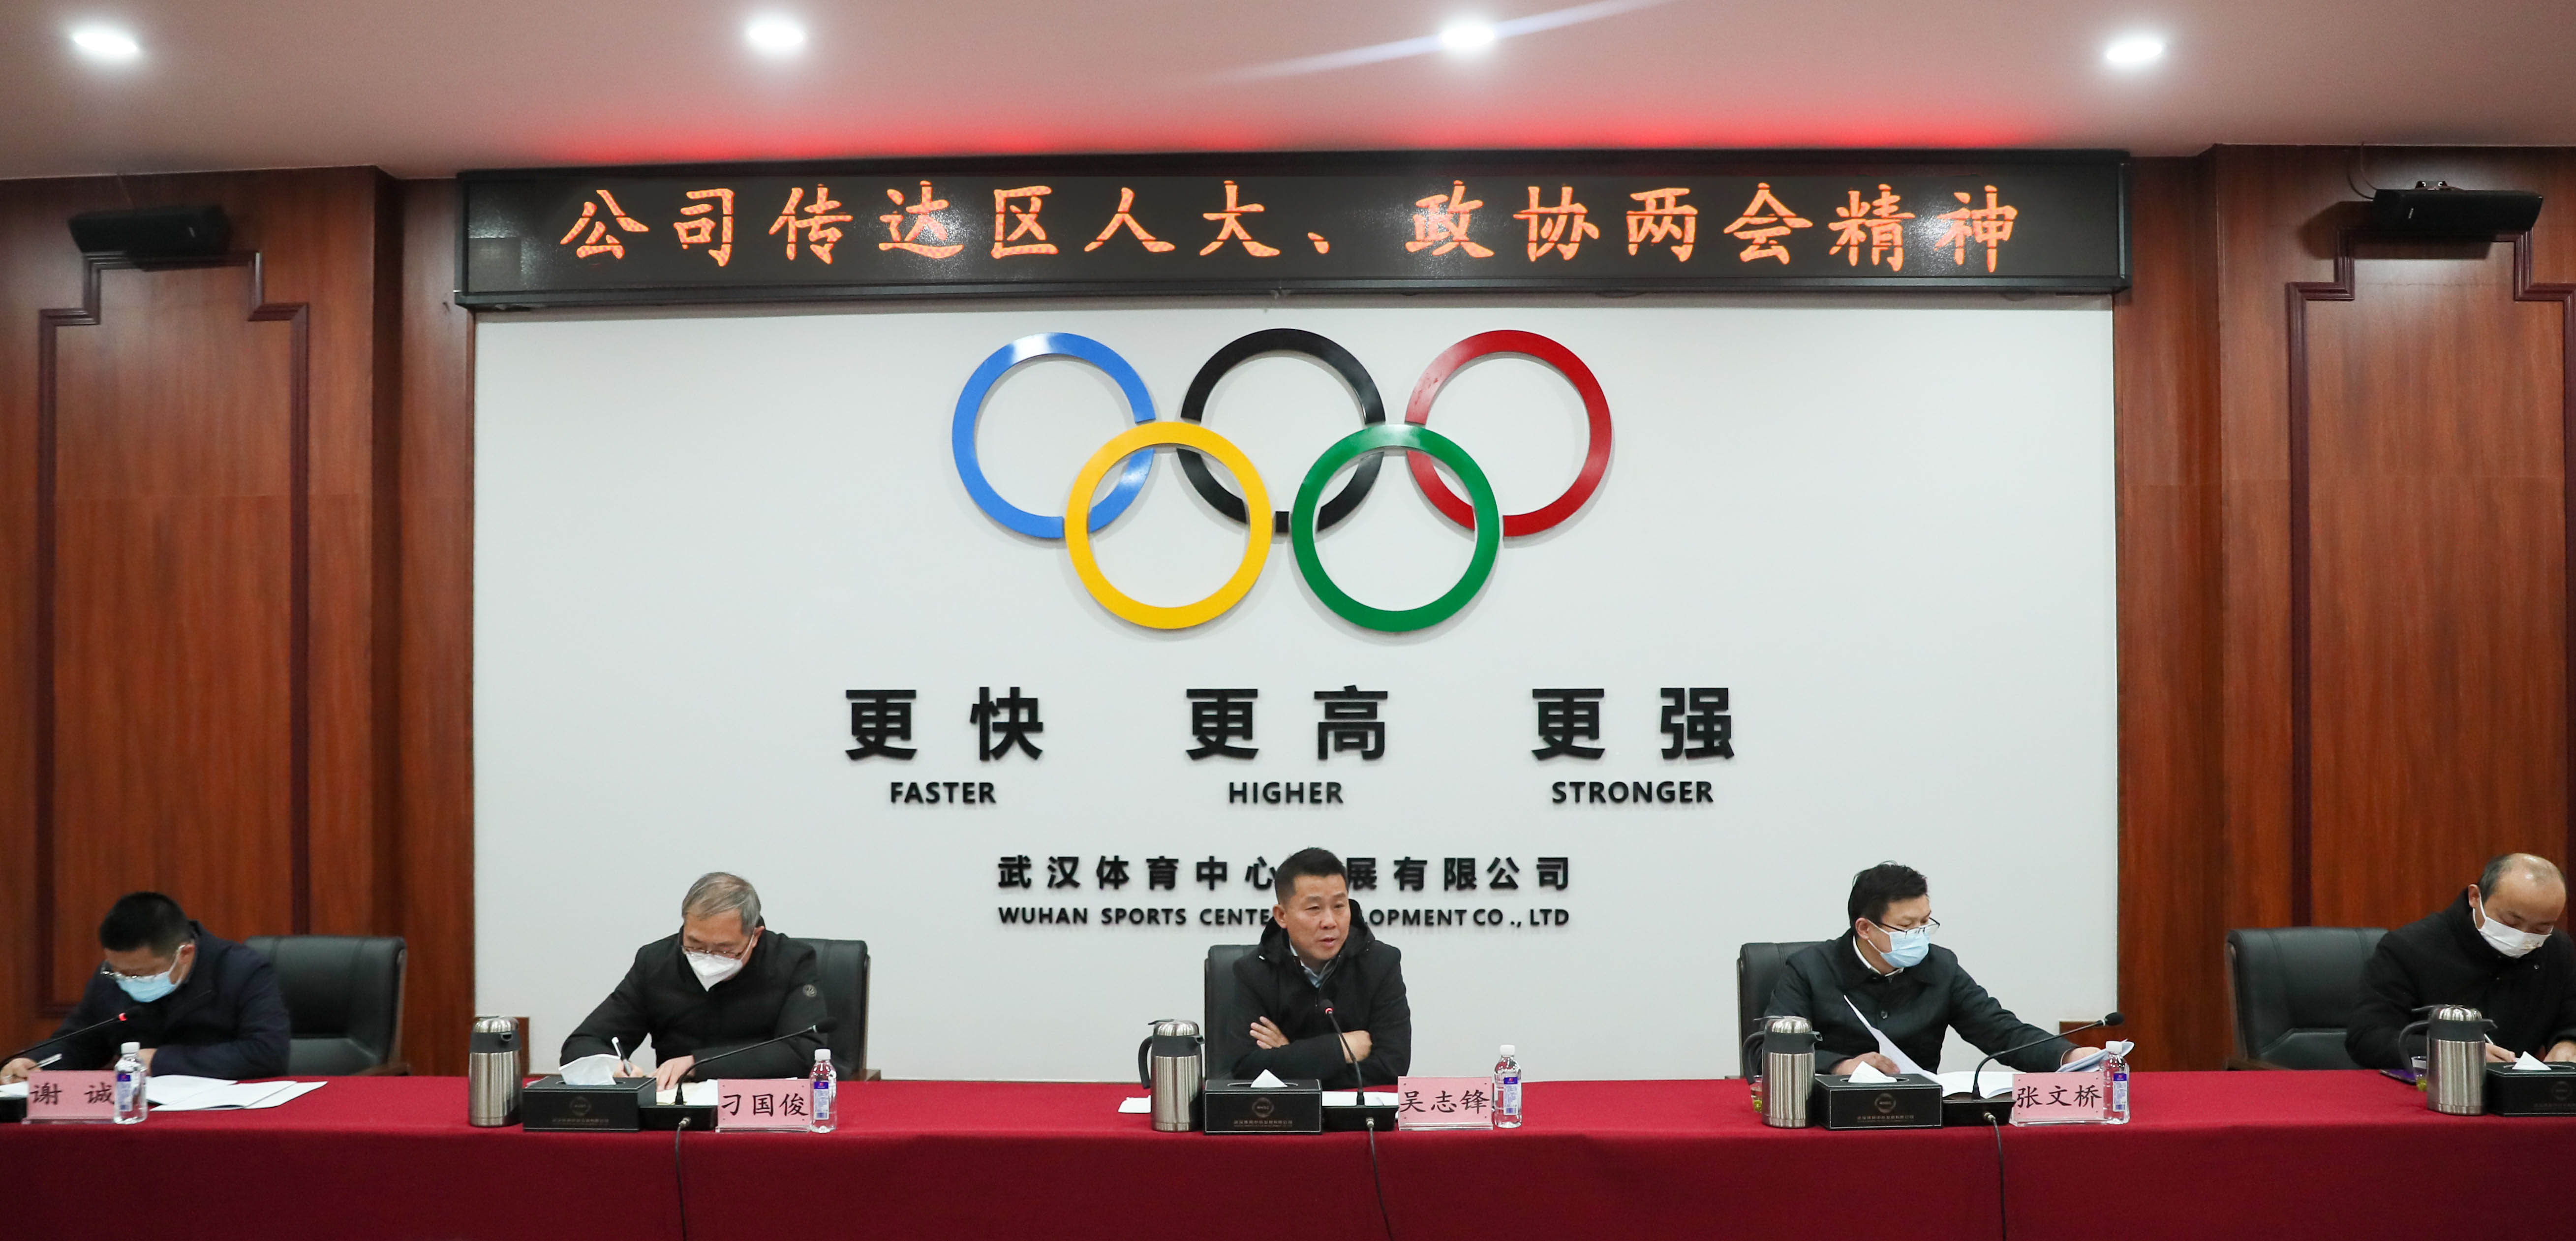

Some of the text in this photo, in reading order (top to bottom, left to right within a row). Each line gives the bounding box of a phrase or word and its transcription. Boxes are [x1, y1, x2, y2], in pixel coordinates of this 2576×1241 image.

[560, 180, 2018, 273] 公司传达区人大、政协两会精神
[891, 781, 996, 805] FASTER
[1228, 781, 1344, 805] HIGHER
[1552, 781, 1714, 805] STRONGER
[998, 855, 1569, 891] 武汉体育中心展有限公司
[998, 908, 1088, 927] WUHAN
[1101, 908, 1187, 927] SPORTS
[1530, 908, 1569, 926] LTD
[721, 1093, 809, 1117] 刁国俊
[1399, 1089, 1490, 1115] 吴志锋
[2017, 1085, 2102, 1108] 张文桥
